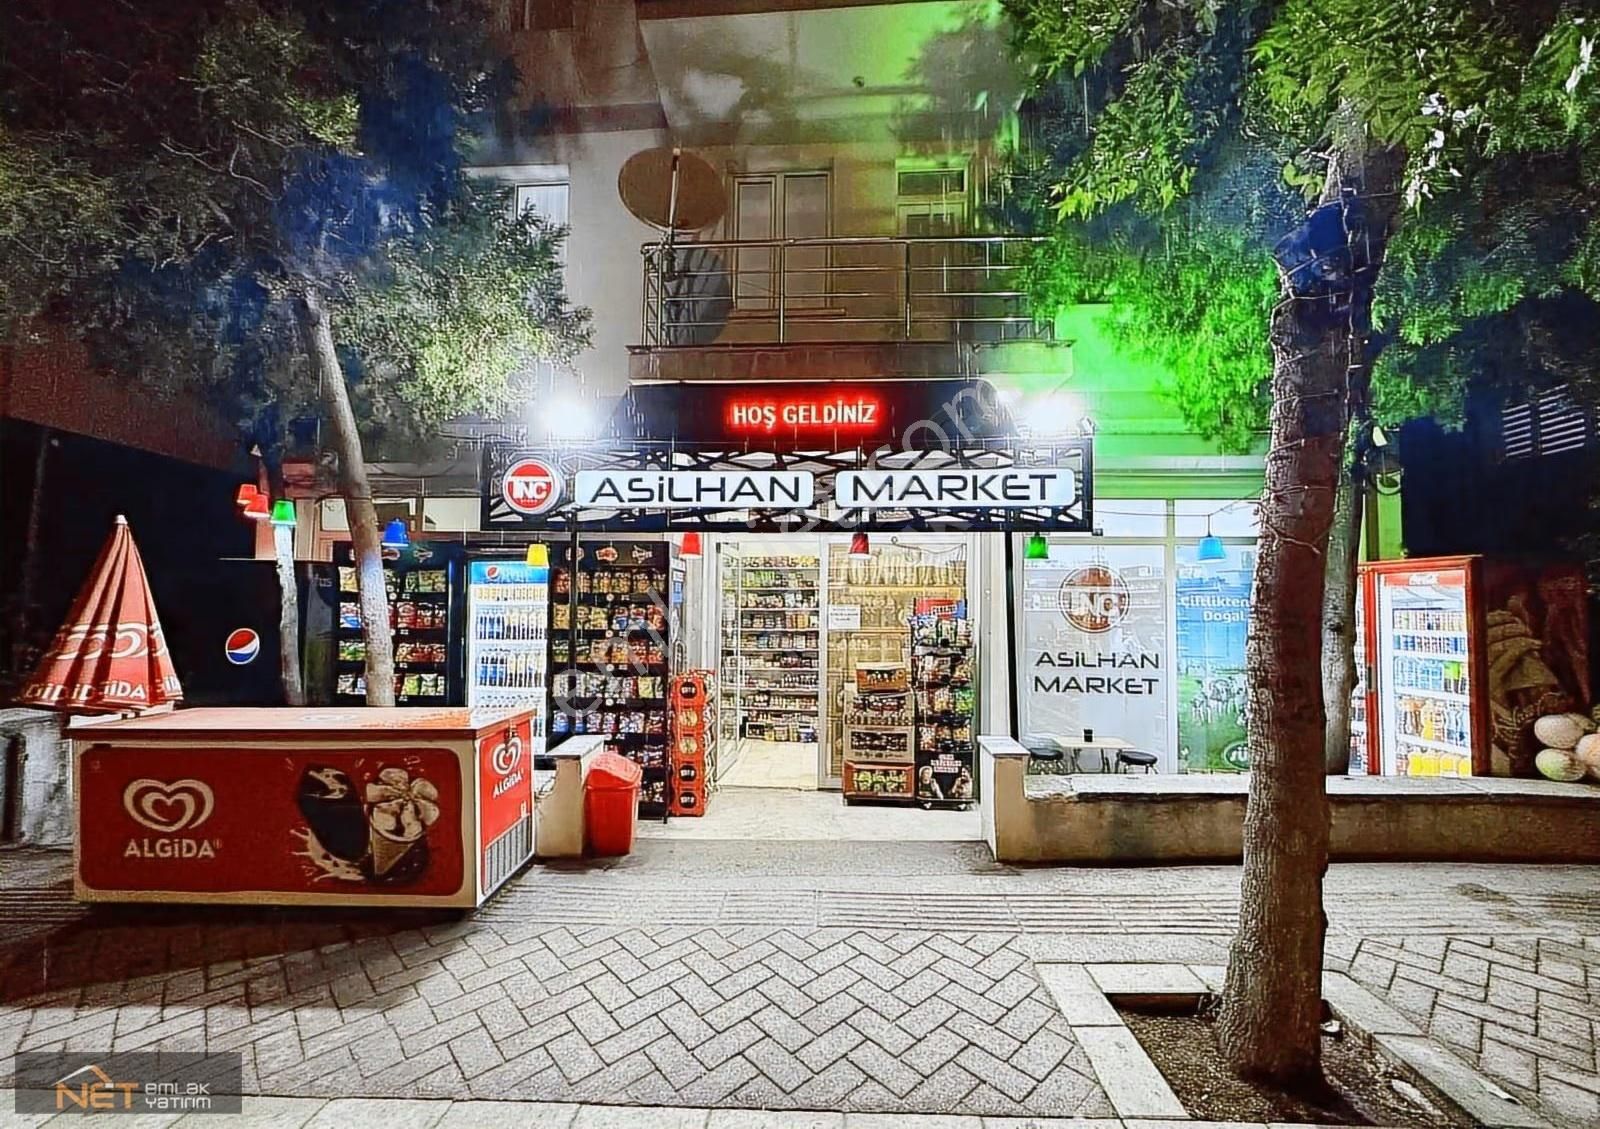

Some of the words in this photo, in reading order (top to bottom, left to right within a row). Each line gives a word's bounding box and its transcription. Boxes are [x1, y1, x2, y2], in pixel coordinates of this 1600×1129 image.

[733, 404, 776, 432] HOŞ
[782, 397, 877, 424] GELDİNİZ
[852, 473, 1058, 502] MARKET
[1034, 676, 1160, 695] MARKET
